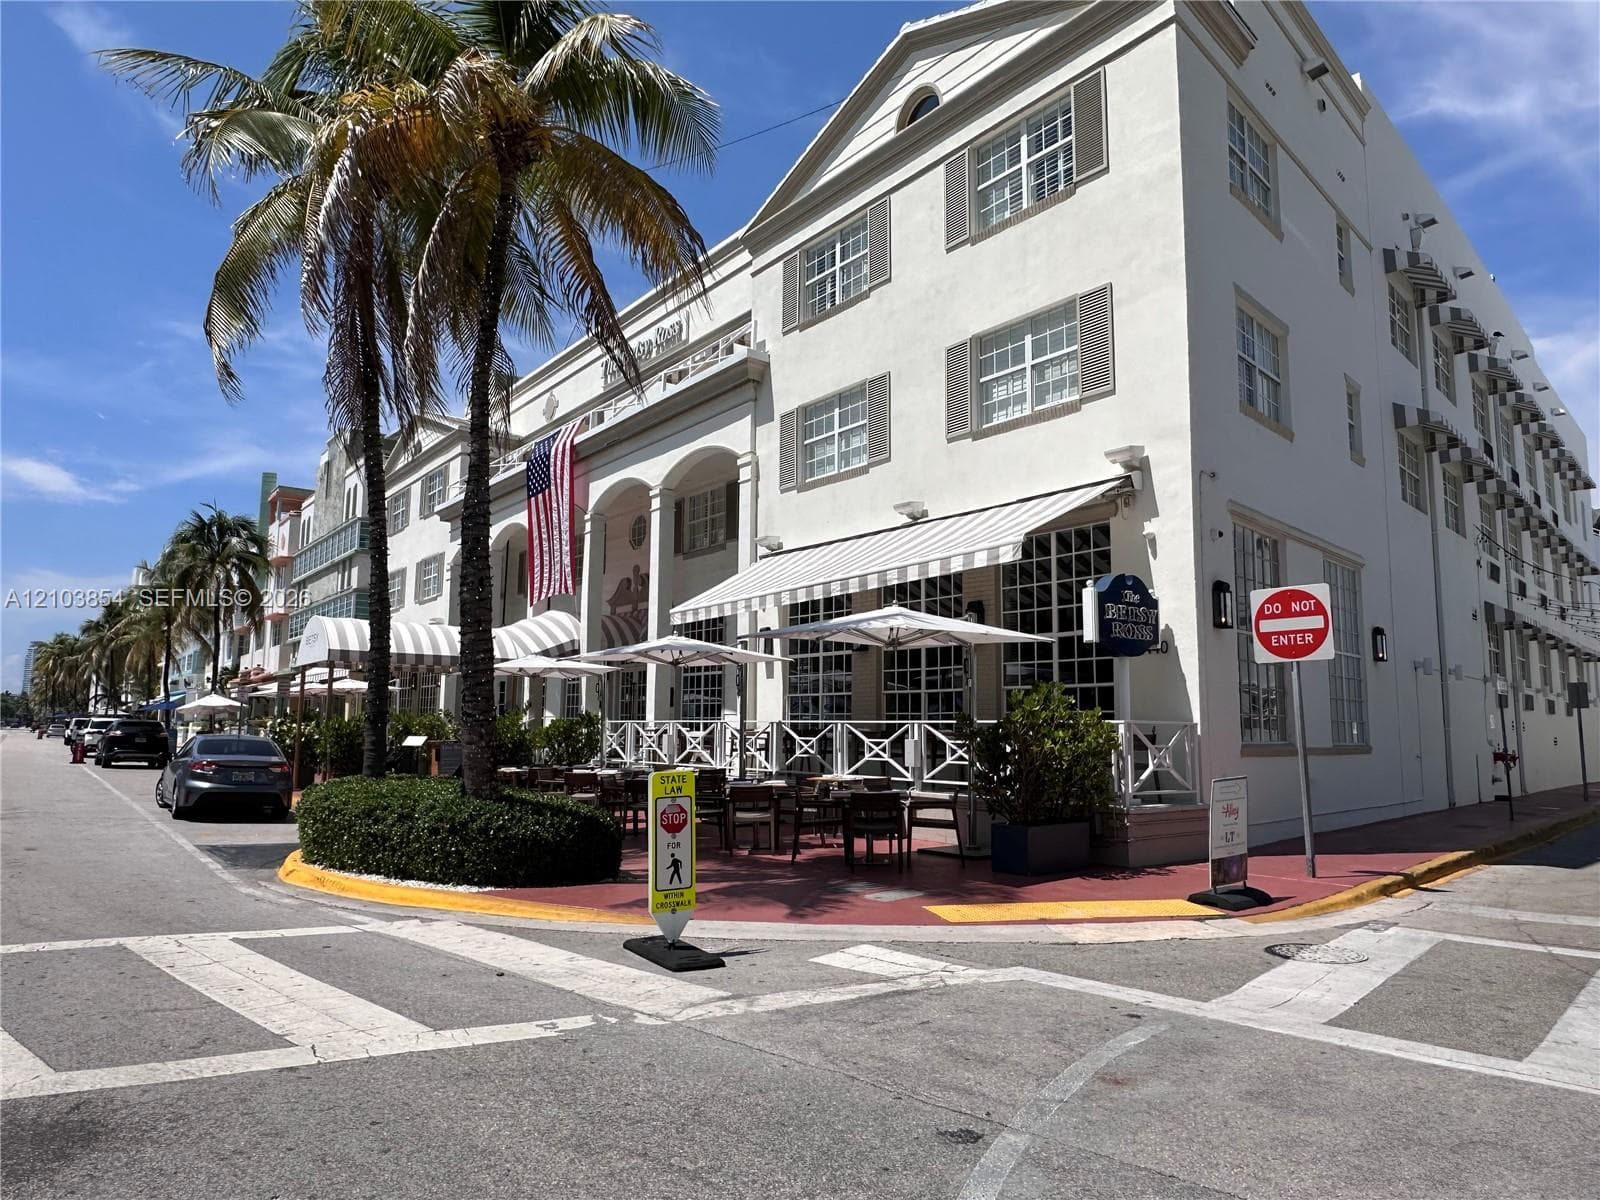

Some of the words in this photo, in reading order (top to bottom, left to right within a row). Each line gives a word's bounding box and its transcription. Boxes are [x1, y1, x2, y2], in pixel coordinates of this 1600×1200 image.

[1121, 590, 1141, 604] The
[1104, 603, 1158, 624] BETSY
[1264, 603, 1282, 615] DO
[1291, 599, 1316, 613] NOT
[1111, 621, 1154, 641] ROSS
[1271, 633, 1314, 647] ENTER
[660, 774, 687, 785] STATE
[664, 785, 683, 796] LAW
[661, 812, 687, 825] STOP
[666, 841, 681, 850] FOR
[663, 891, 685, 900] WITHIN
[655, 900, 692, 910] CROSSWALK
